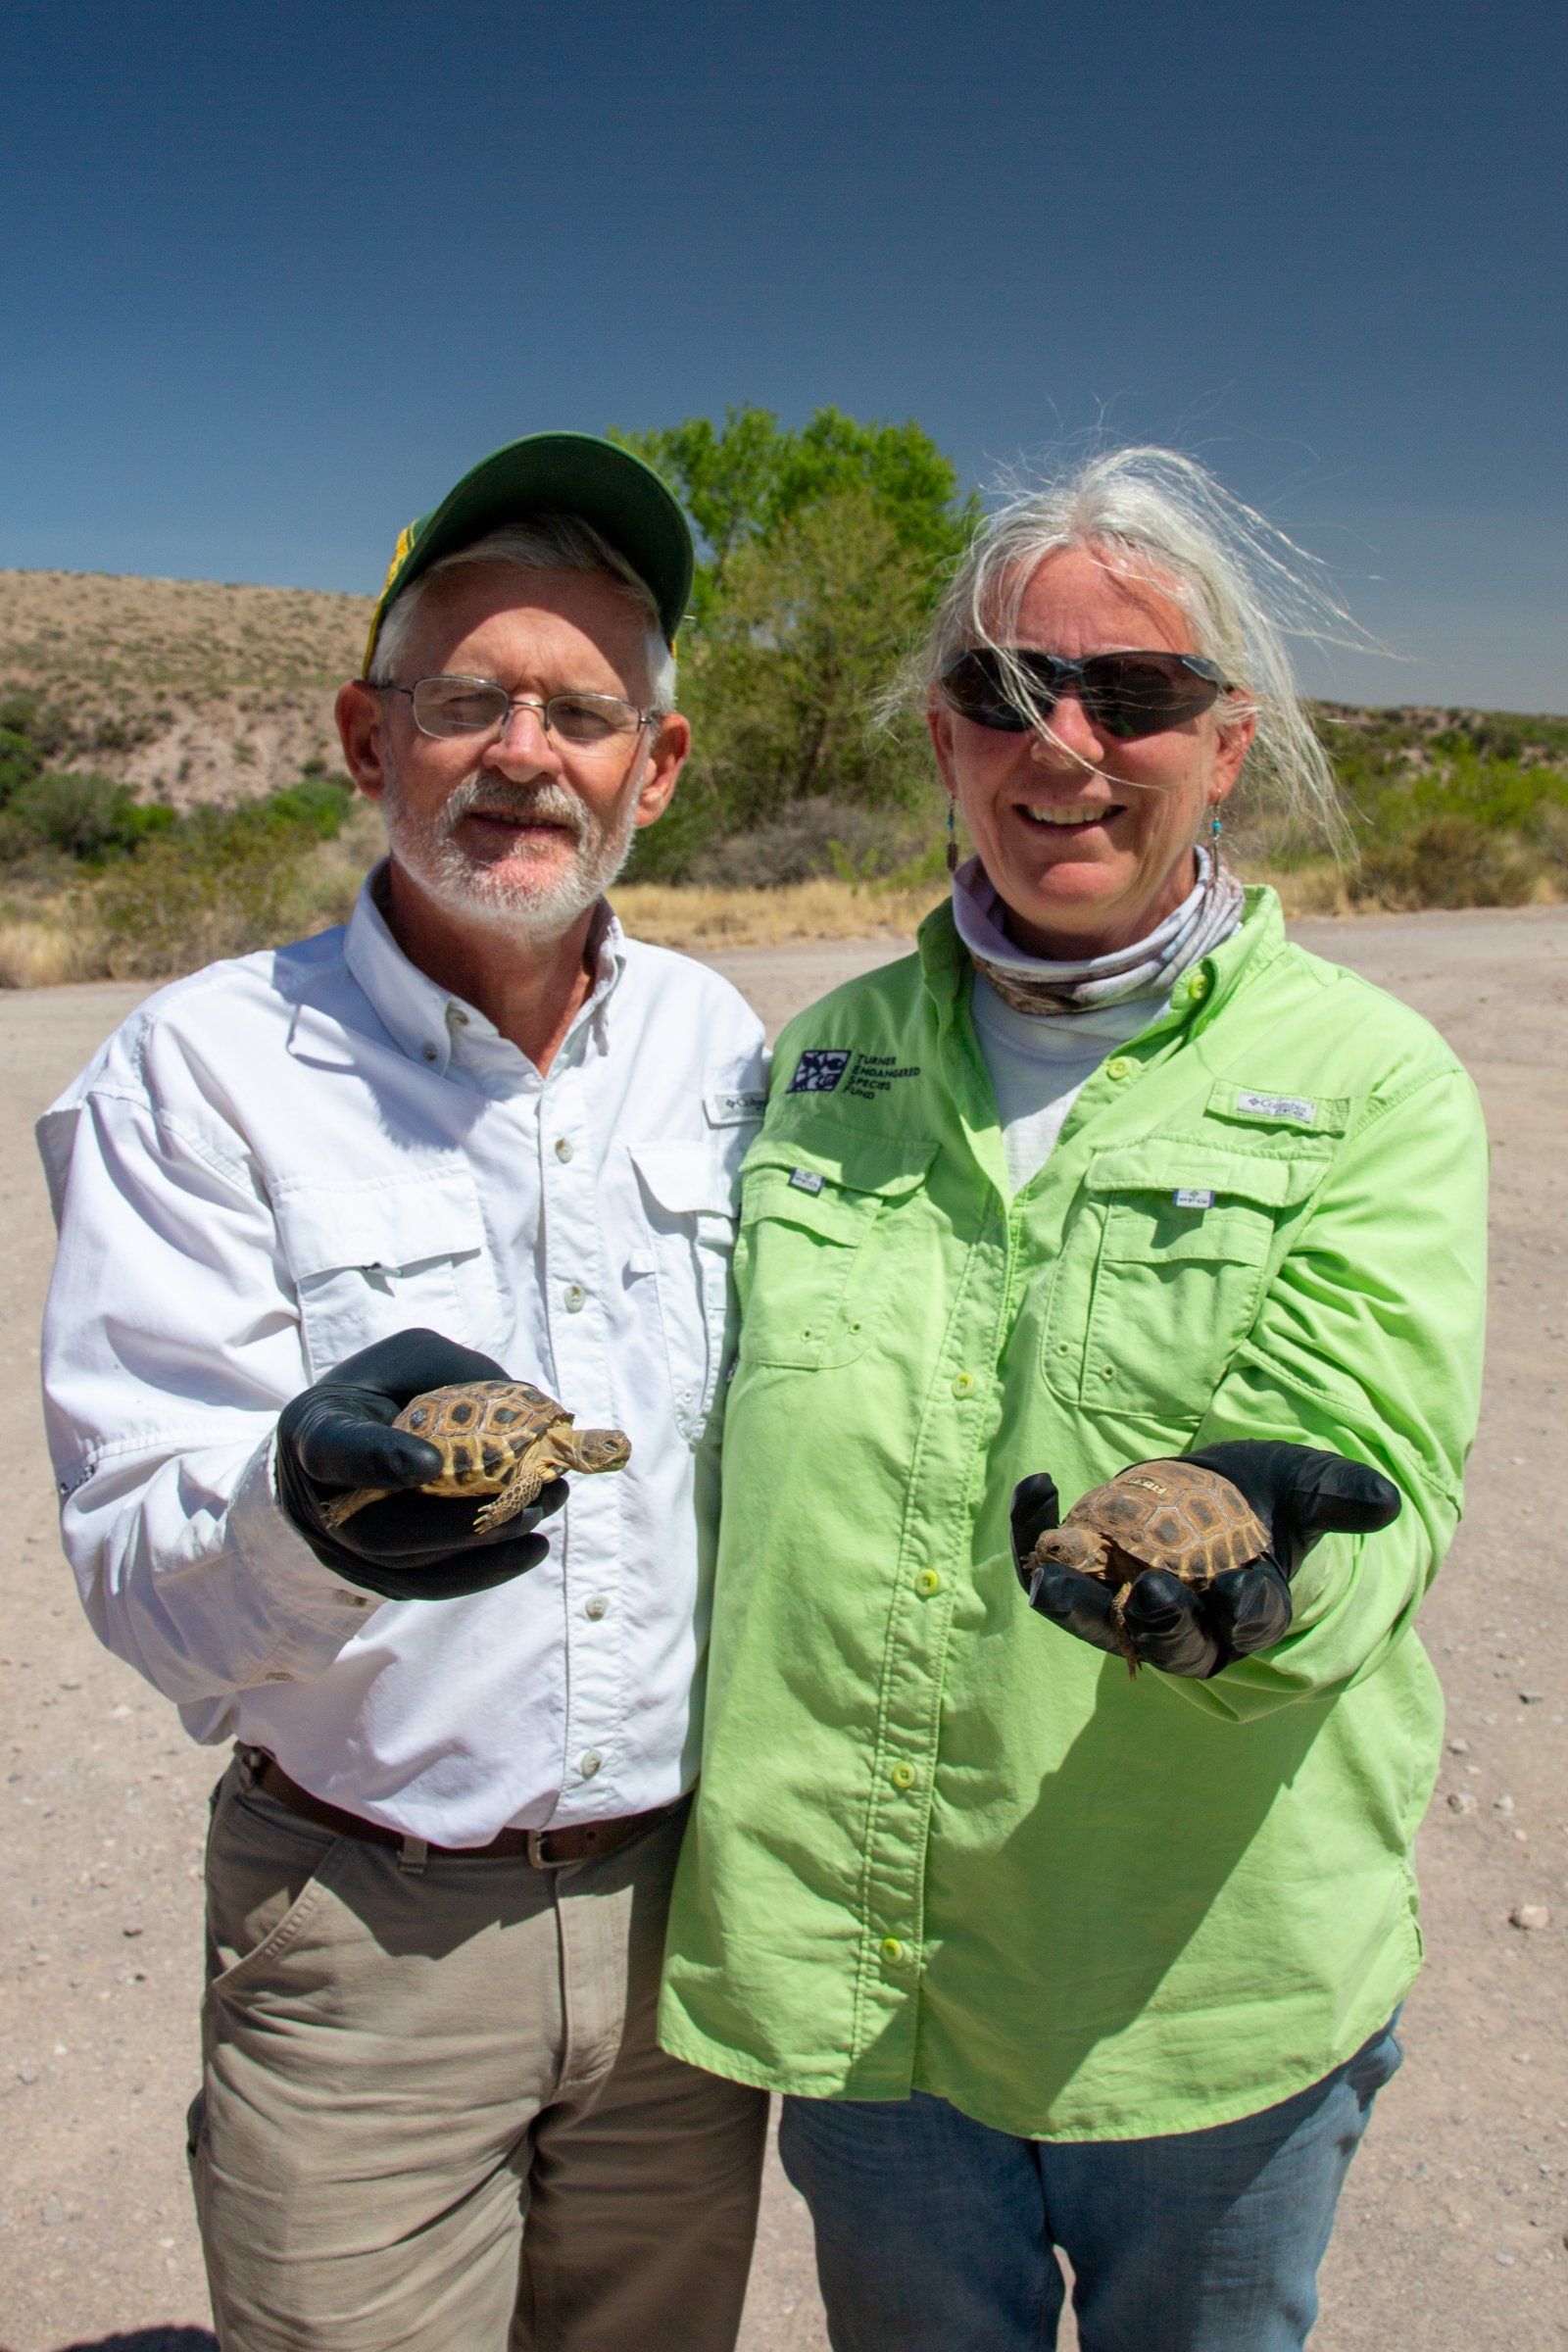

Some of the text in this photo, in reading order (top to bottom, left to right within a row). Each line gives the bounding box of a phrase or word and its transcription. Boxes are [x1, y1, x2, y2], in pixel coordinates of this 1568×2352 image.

[858, 1054, 897, 1066] TURNER
[853, 1065, 921, 1078] ENDANGERED
[848, 1075, 892, 1091] SPECIES
[843, 1084, 876, 1100] FUND
